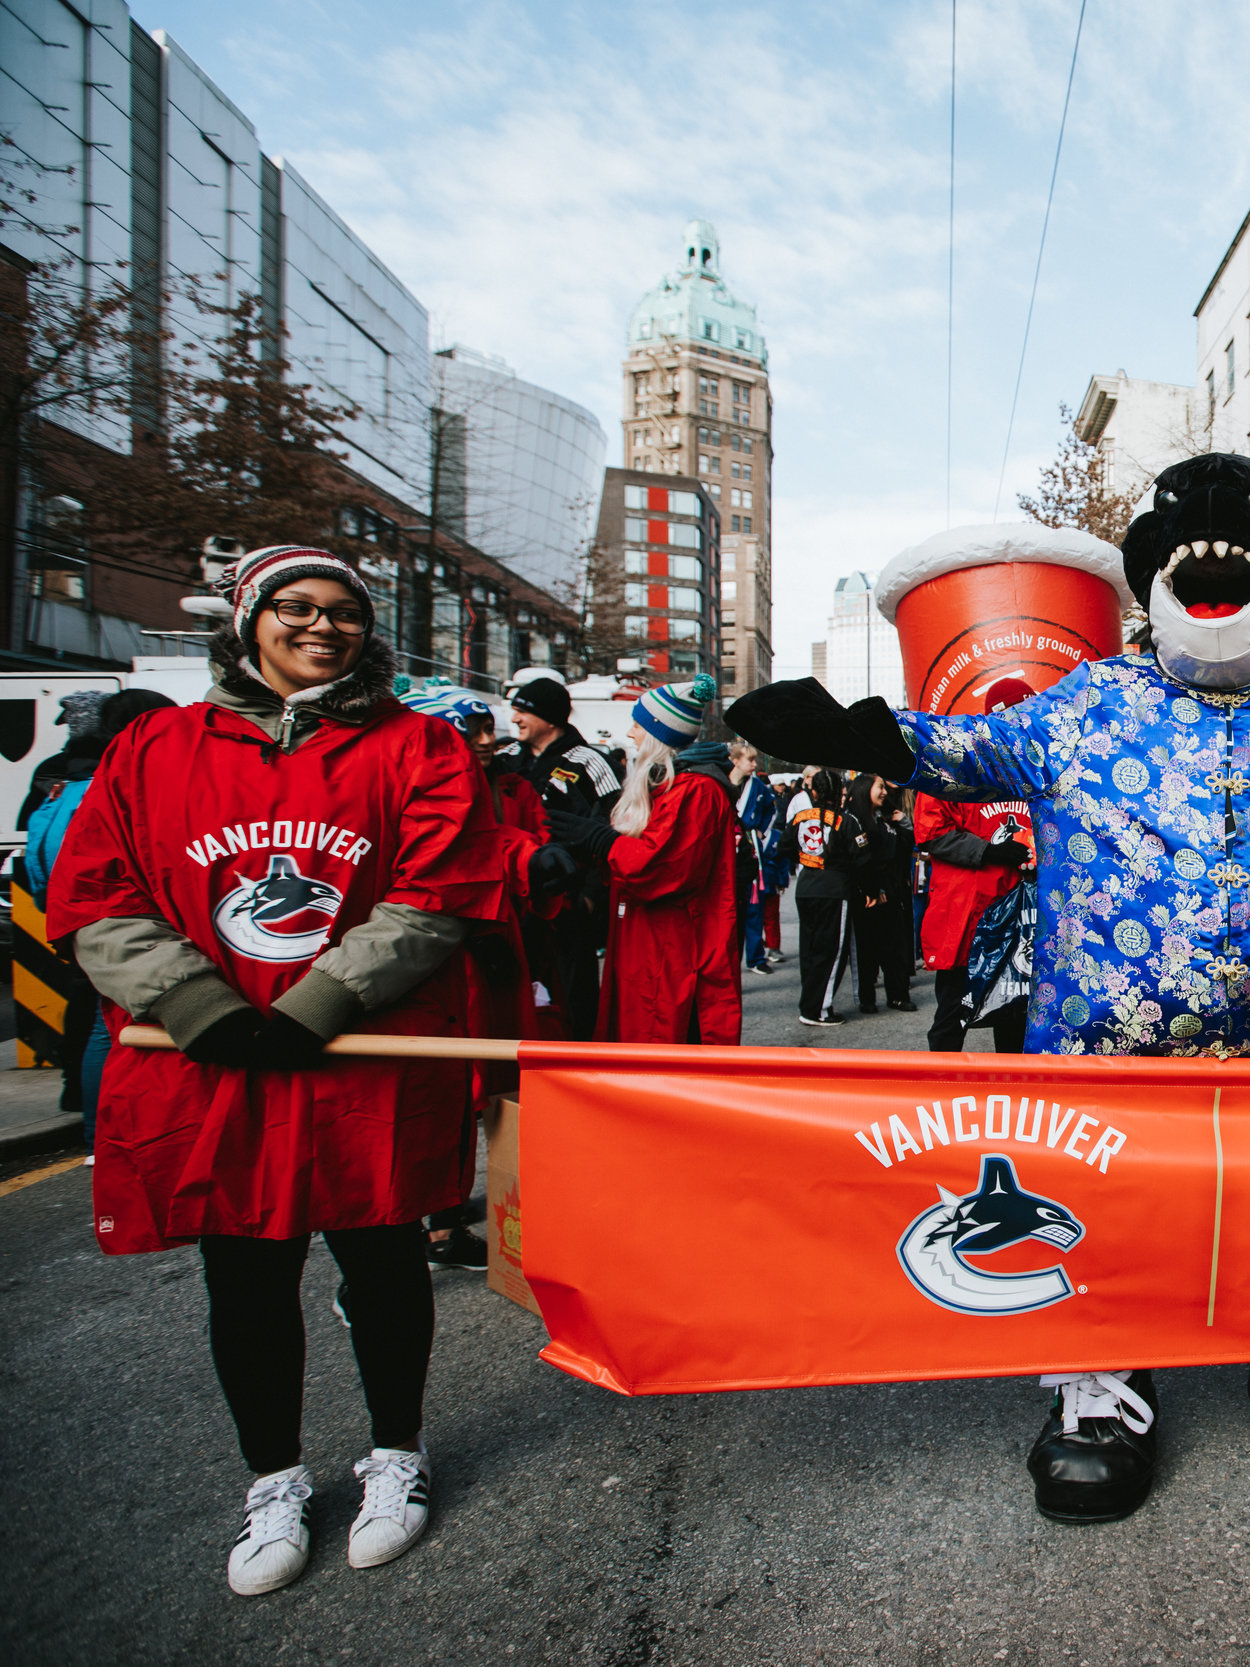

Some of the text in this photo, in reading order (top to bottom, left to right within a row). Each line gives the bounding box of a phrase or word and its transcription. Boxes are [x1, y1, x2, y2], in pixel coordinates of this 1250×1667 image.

[947, 651, 973, 679] milk
[971, 643, 985, 659] &
[984, 631, 1034, 653] freshly
[1036, 636, 1082, 662] ground
[186, 820, 372, 868] VANCOUVER
[1000, 981, 1031, 996] TEAM
[854, 1094, 1128, 1175] VANCOUVER
